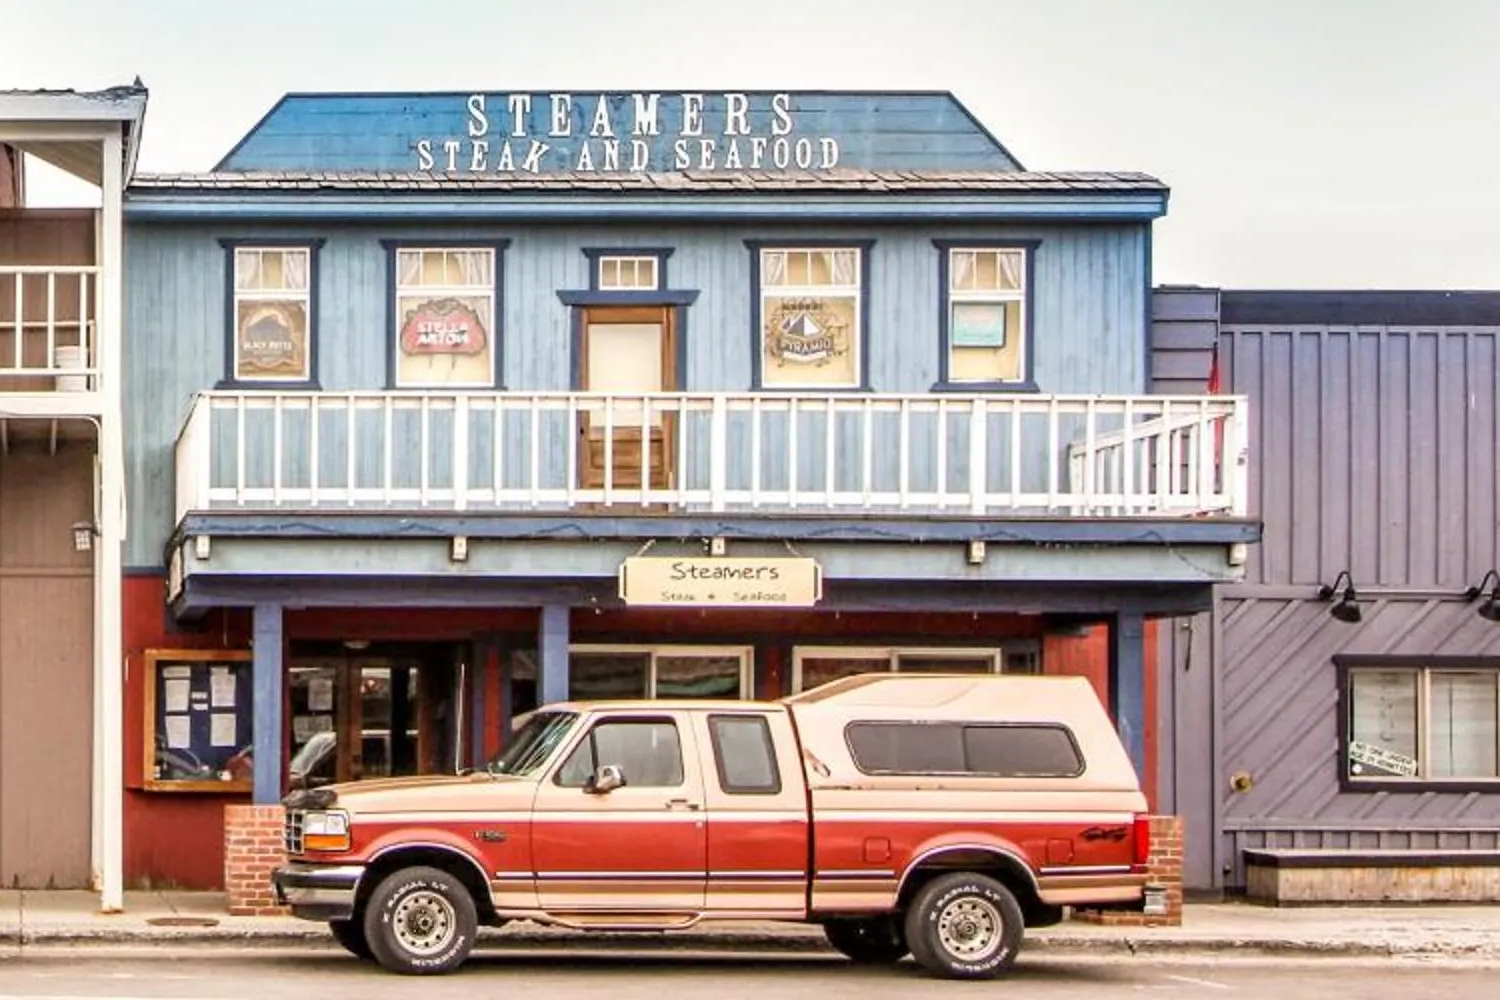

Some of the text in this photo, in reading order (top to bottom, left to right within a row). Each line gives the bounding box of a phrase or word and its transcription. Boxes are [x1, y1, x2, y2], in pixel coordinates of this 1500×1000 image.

[467, 94, 793, 137] STEAMERS
[417, 138, 839, 173] STEAK AND SEAFOOD
[670, 562, 780, 580] Steamers
